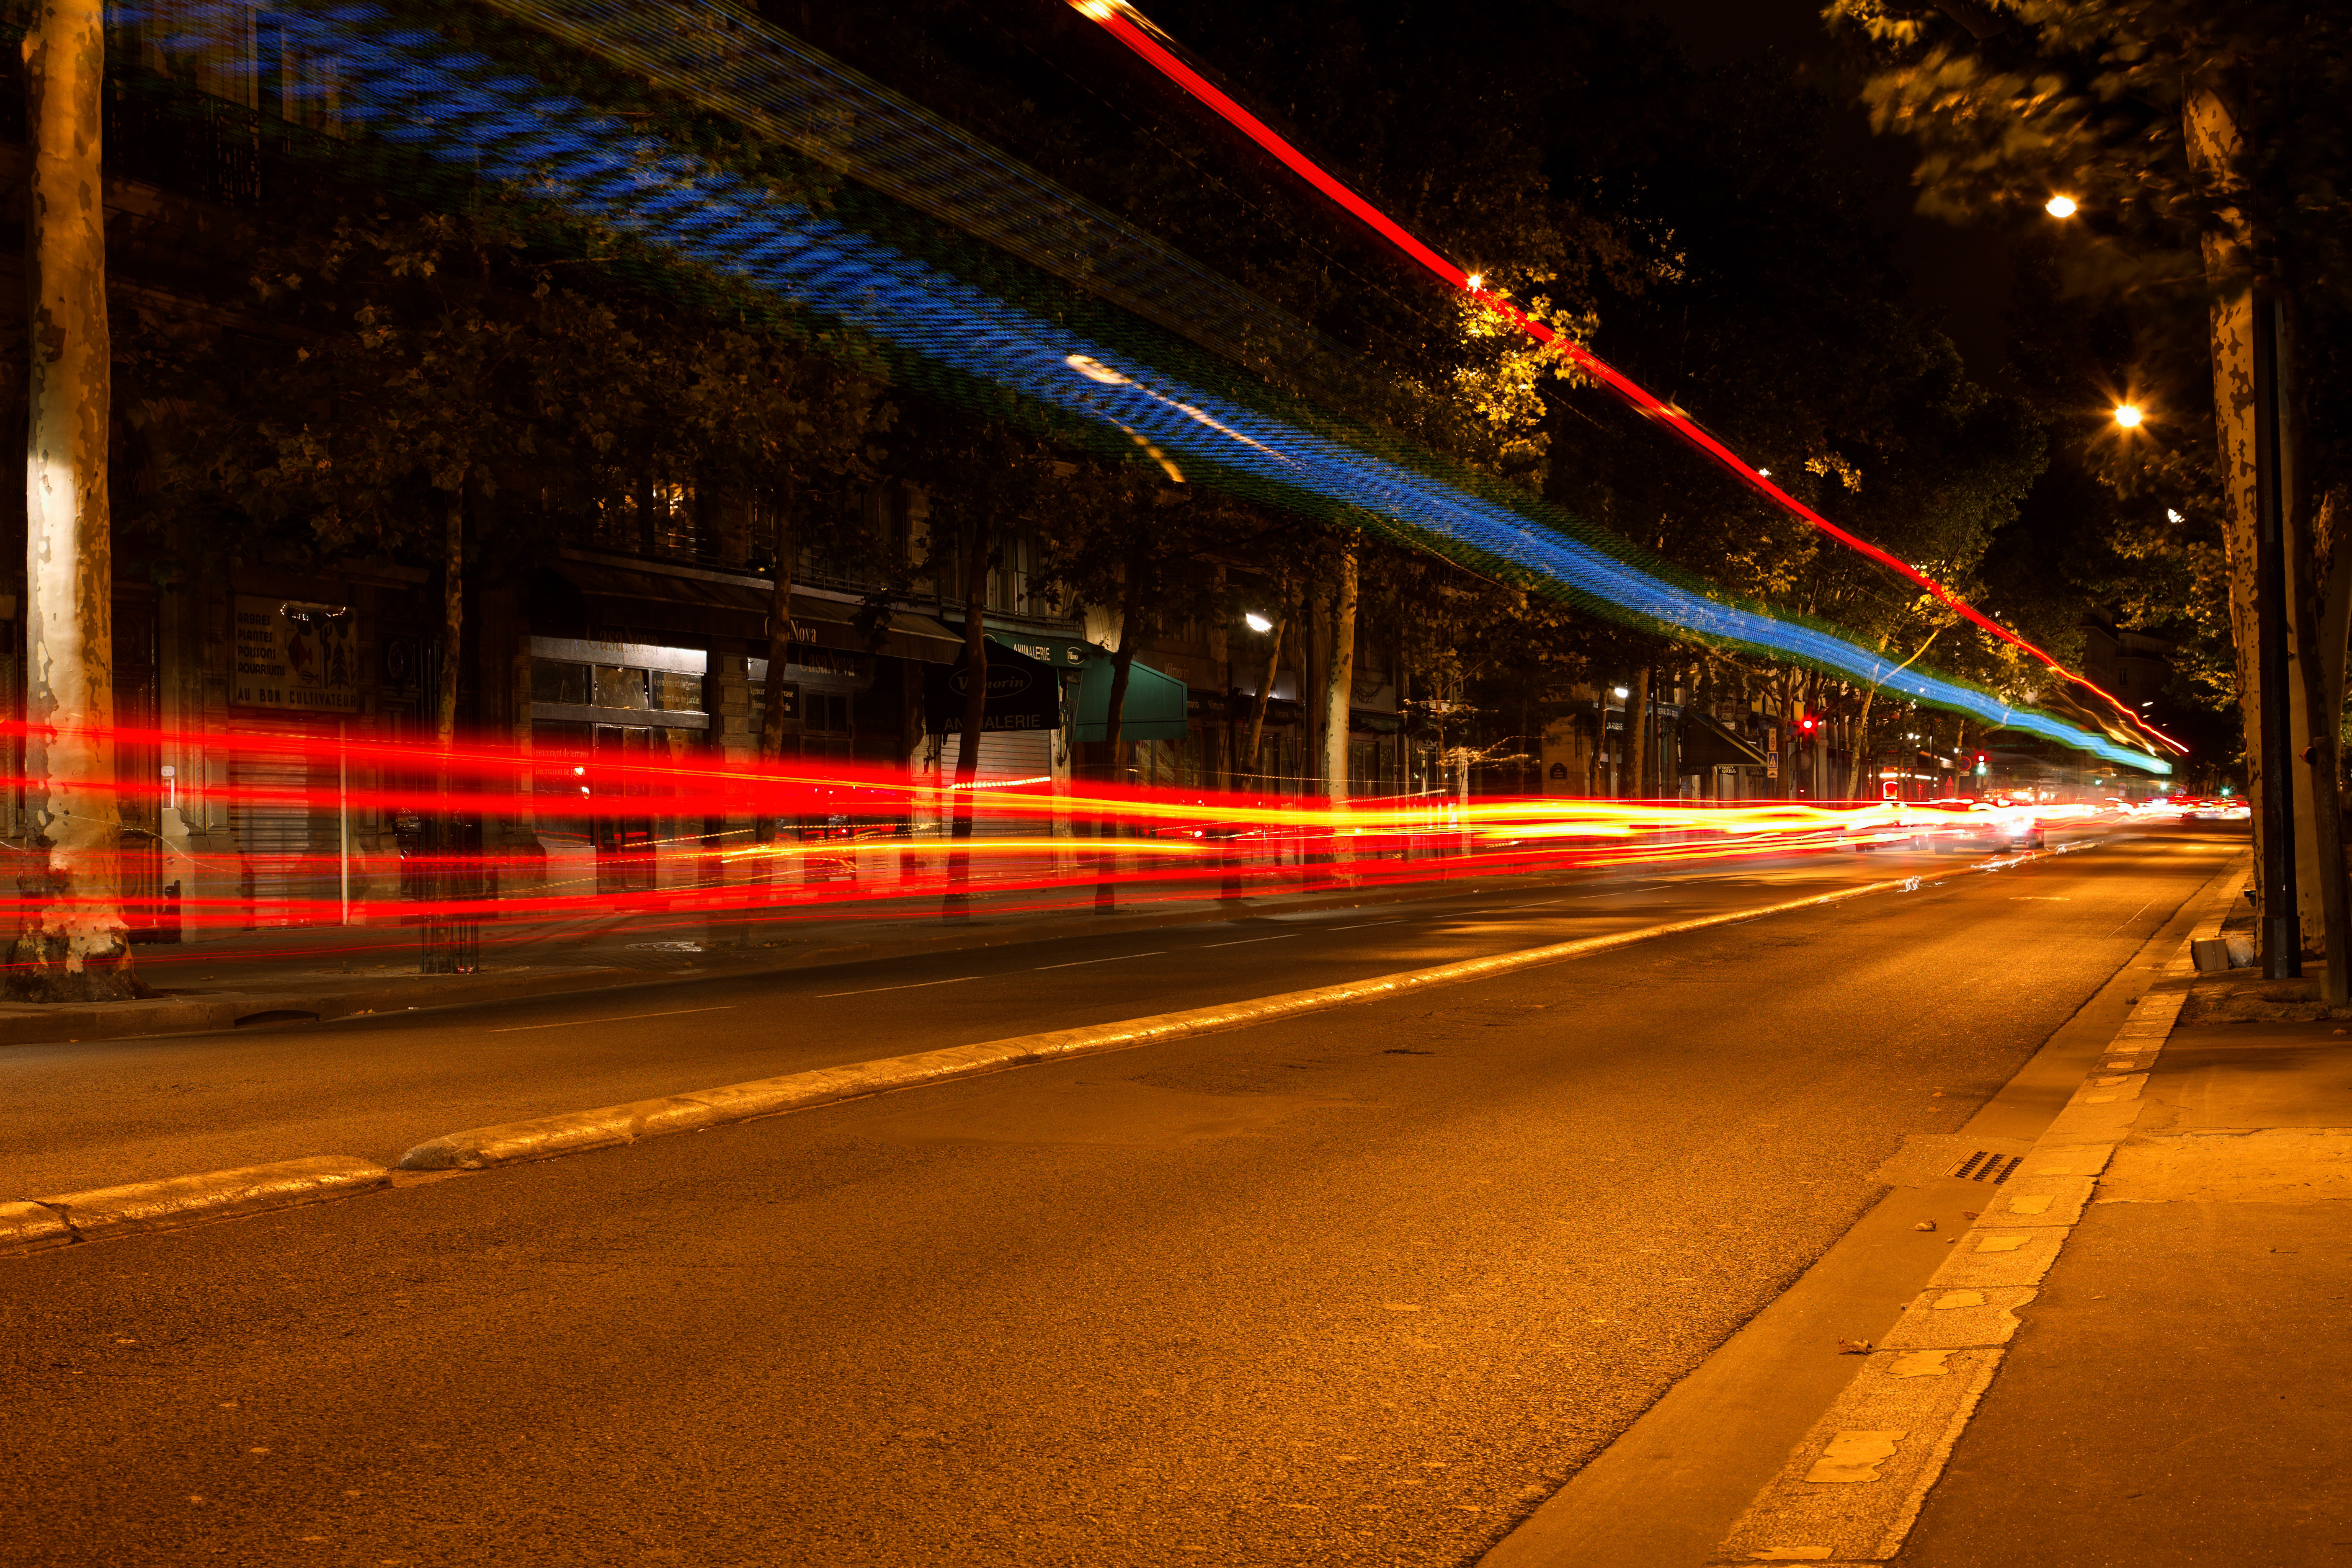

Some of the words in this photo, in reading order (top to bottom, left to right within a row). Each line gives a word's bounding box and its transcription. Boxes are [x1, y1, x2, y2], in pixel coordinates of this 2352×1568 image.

[237, 612, 270, 626] ARBRES
[237, 629, 272, 642] PLANTES
[765, 616, 816, 643] CNova
[587, 623, 658, 655] CasaNova
[238, 646, 276, 659] POISSONS
[1164, 662, 1189, 679] Vilmorin
[653, 677, 679, 689] Agencement
[680, 679, 686, 688] de
[957, 676, 1024, 690] Vmorin
[237, 687, 250, 701] AU
[260, 689, 280, 702] BON
[290, 691, 356, 707] CULTIVATEUR
[656, 691, 680, 703] Décoration
[681, 694, 686, 704] de
[686, 694, 700, 705] jardin
[749, 686, 766, 696] Agence
[752, 700, 766, 709] Décora
[944, 714, 1041, 731] ANALERIE
[532, 748, 562, 758] Agencement
[563, 748, 569, 758] de
[570, 749, 589, 758] terrasse
[564, 766, 570, 776] de
